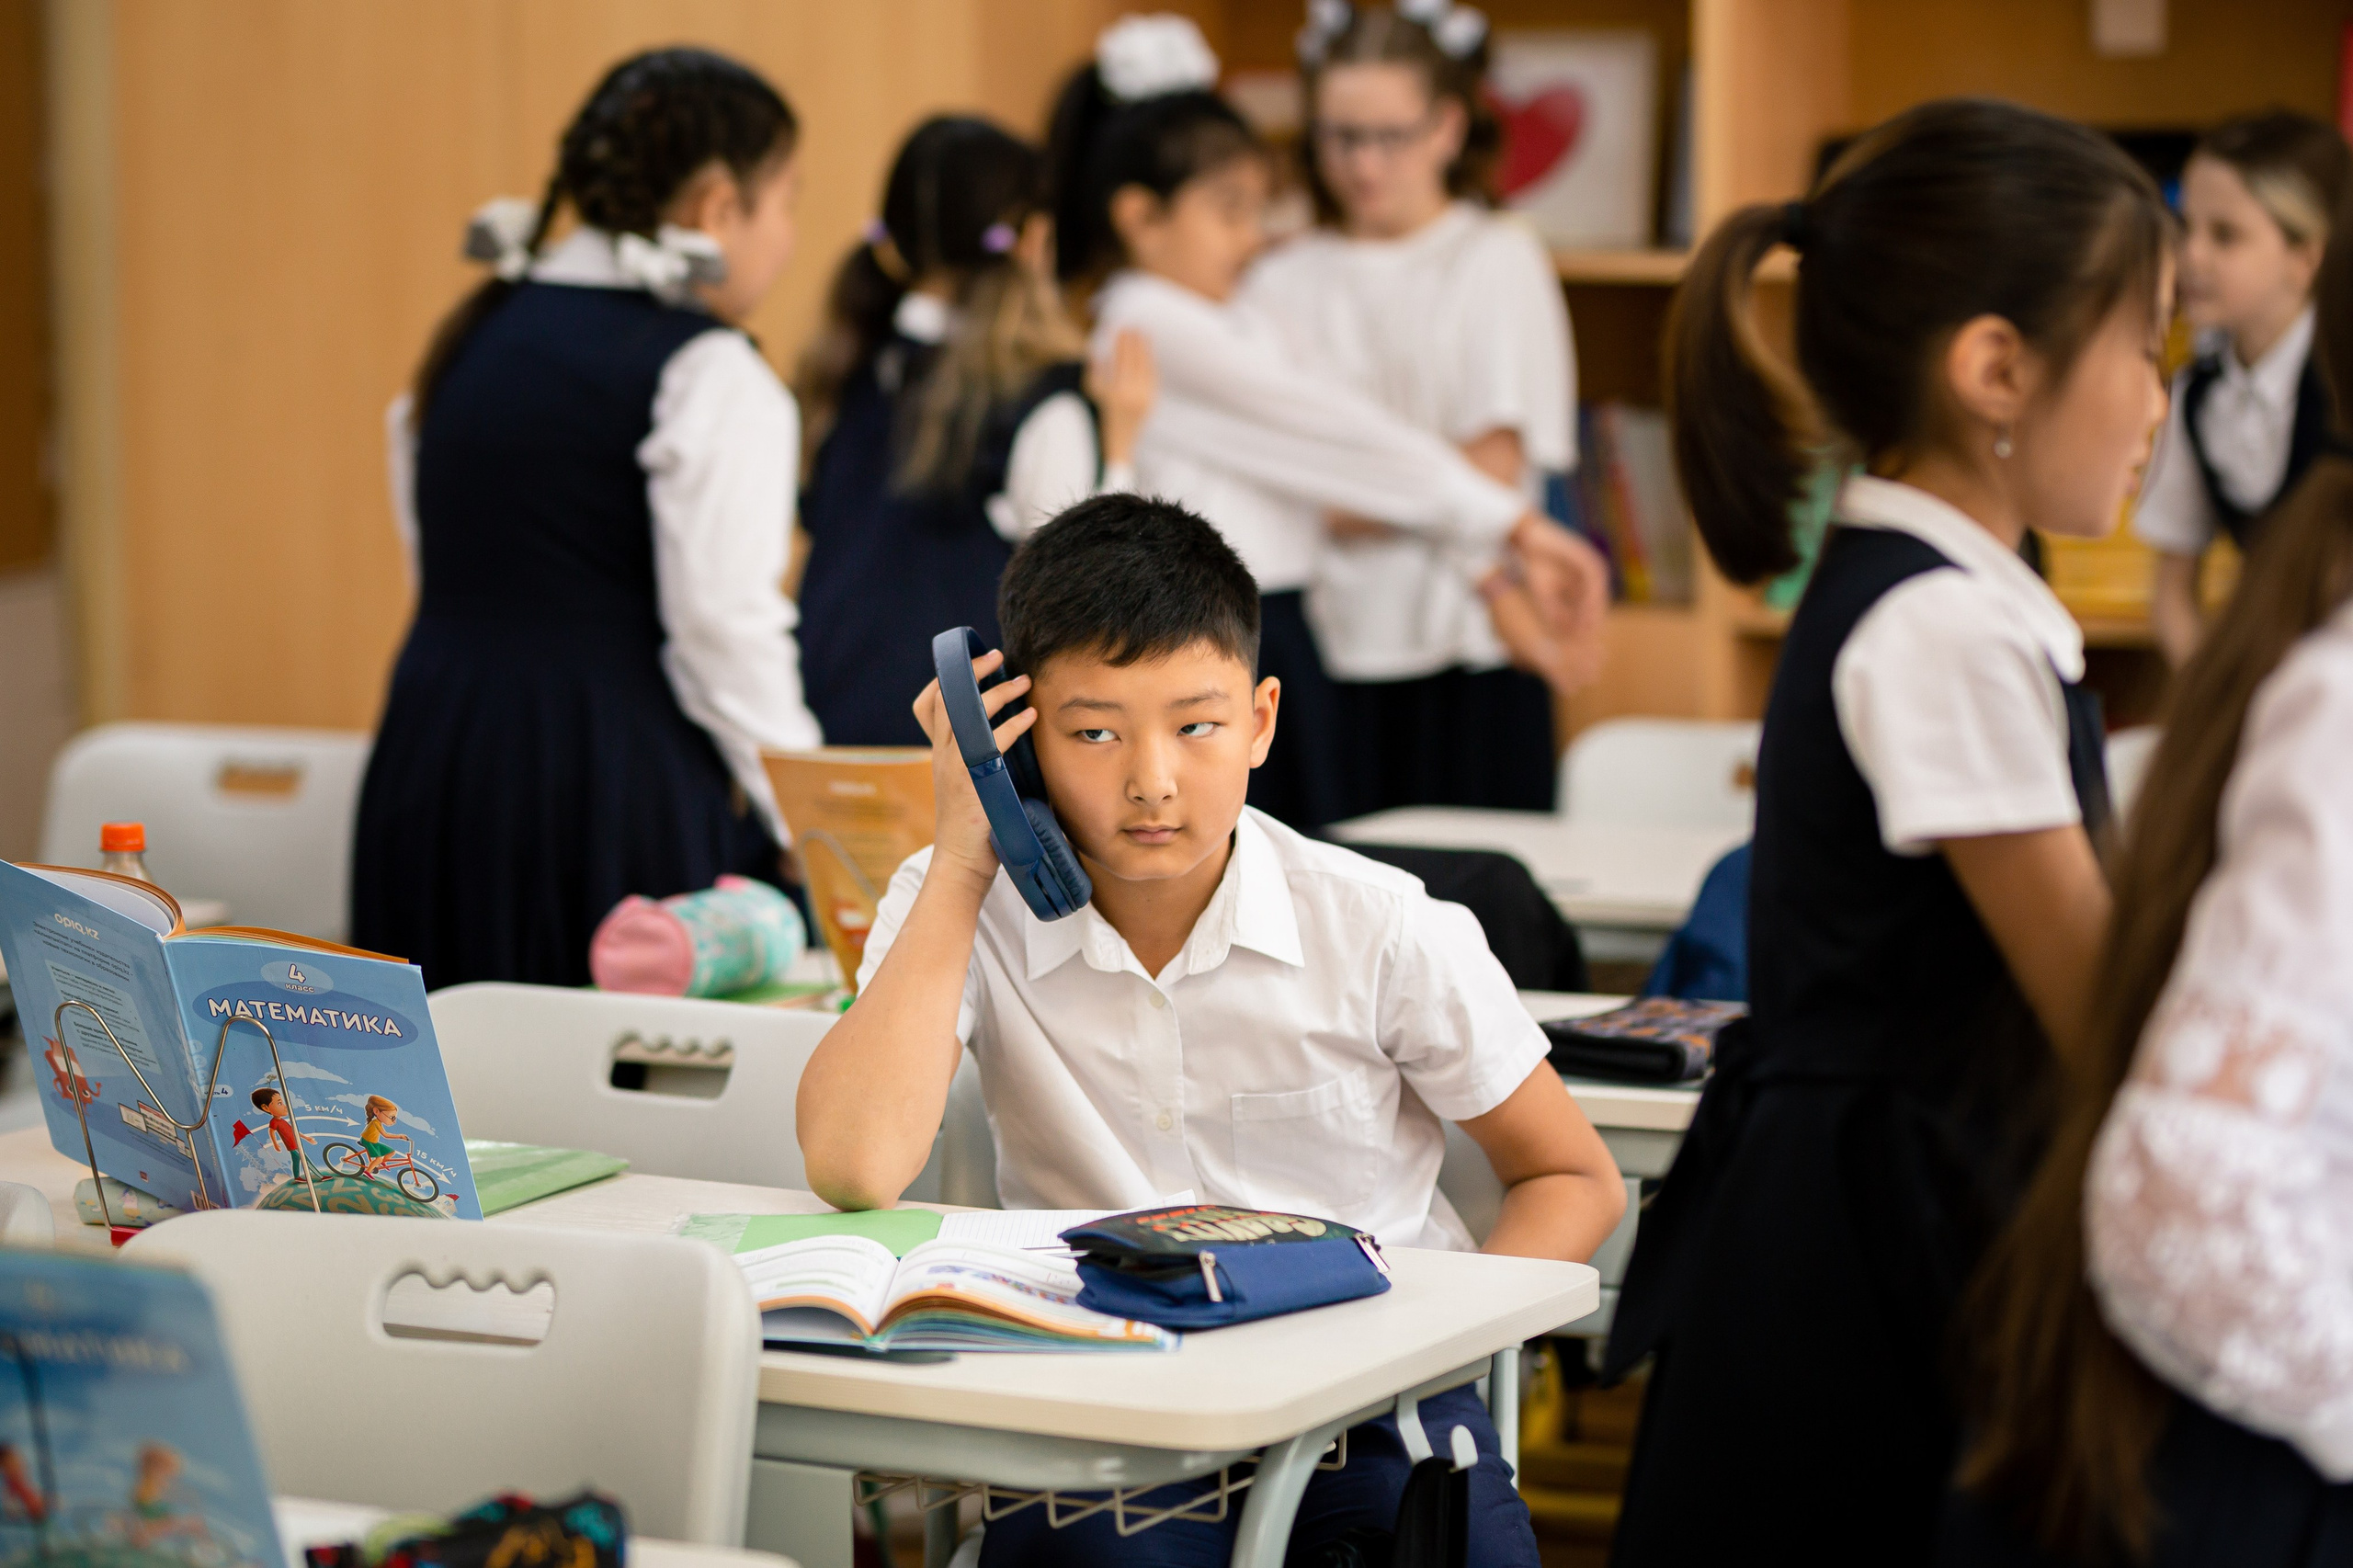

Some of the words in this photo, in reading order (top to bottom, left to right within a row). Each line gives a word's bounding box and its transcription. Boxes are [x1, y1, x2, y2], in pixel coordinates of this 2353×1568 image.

[288, 963, 306, 983] 4
[285, 983, 315, 994] класс
[207, 997, 403, 1038] МАТЕМАТИКА
[304, 1104, 313, 1112] 5
[416, 1149, 428, 1160] 15
